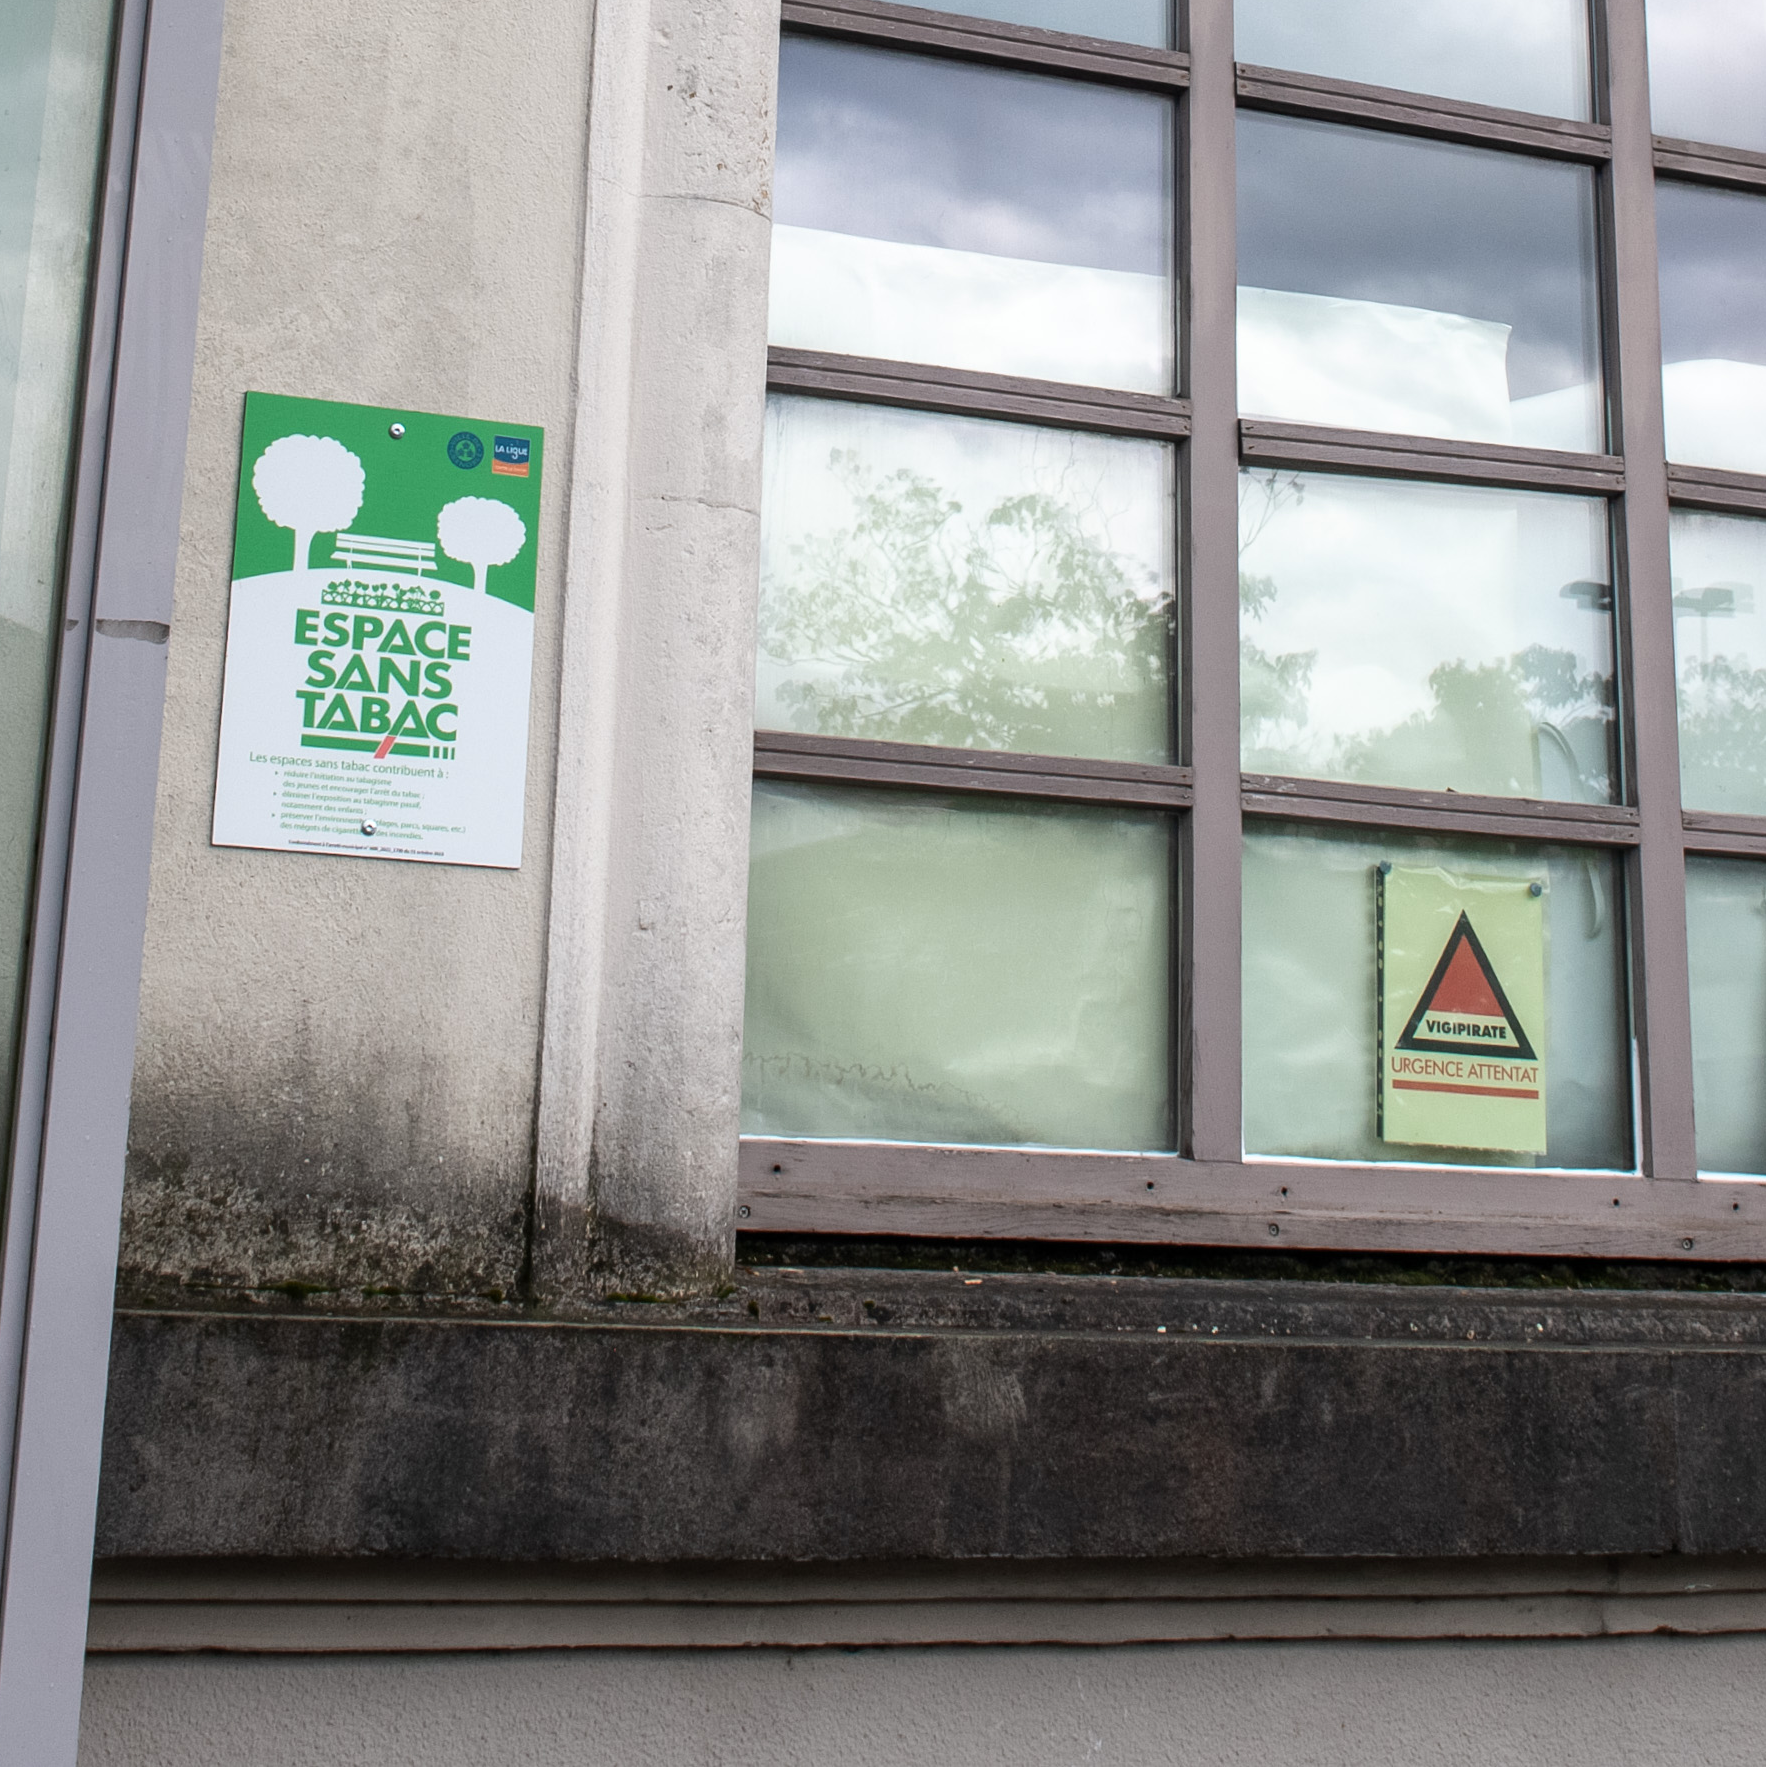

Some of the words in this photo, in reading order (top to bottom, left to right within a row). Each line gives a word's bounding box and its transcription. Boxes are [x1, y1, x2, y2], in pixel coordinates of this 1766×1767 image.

[294, 608, 472, 661] ESPACE
[305, 650, 453, 699] SANS
[296, 690, 458, 742] TABAC
[249, 752, 268, 764] Les
[270, 755, 312, 767] espaces
[315, 759, 338, 769] sans
[341, 760, 371, 772] tabac
[373, 763, 435, 778] contribuent
[1426, 1019, 1506, 1039] VIGIPIRATE
[1391, 1056, 1463, 1078] URGENCE
[1467, 1063, 1539, 1083] ATTENTAT
